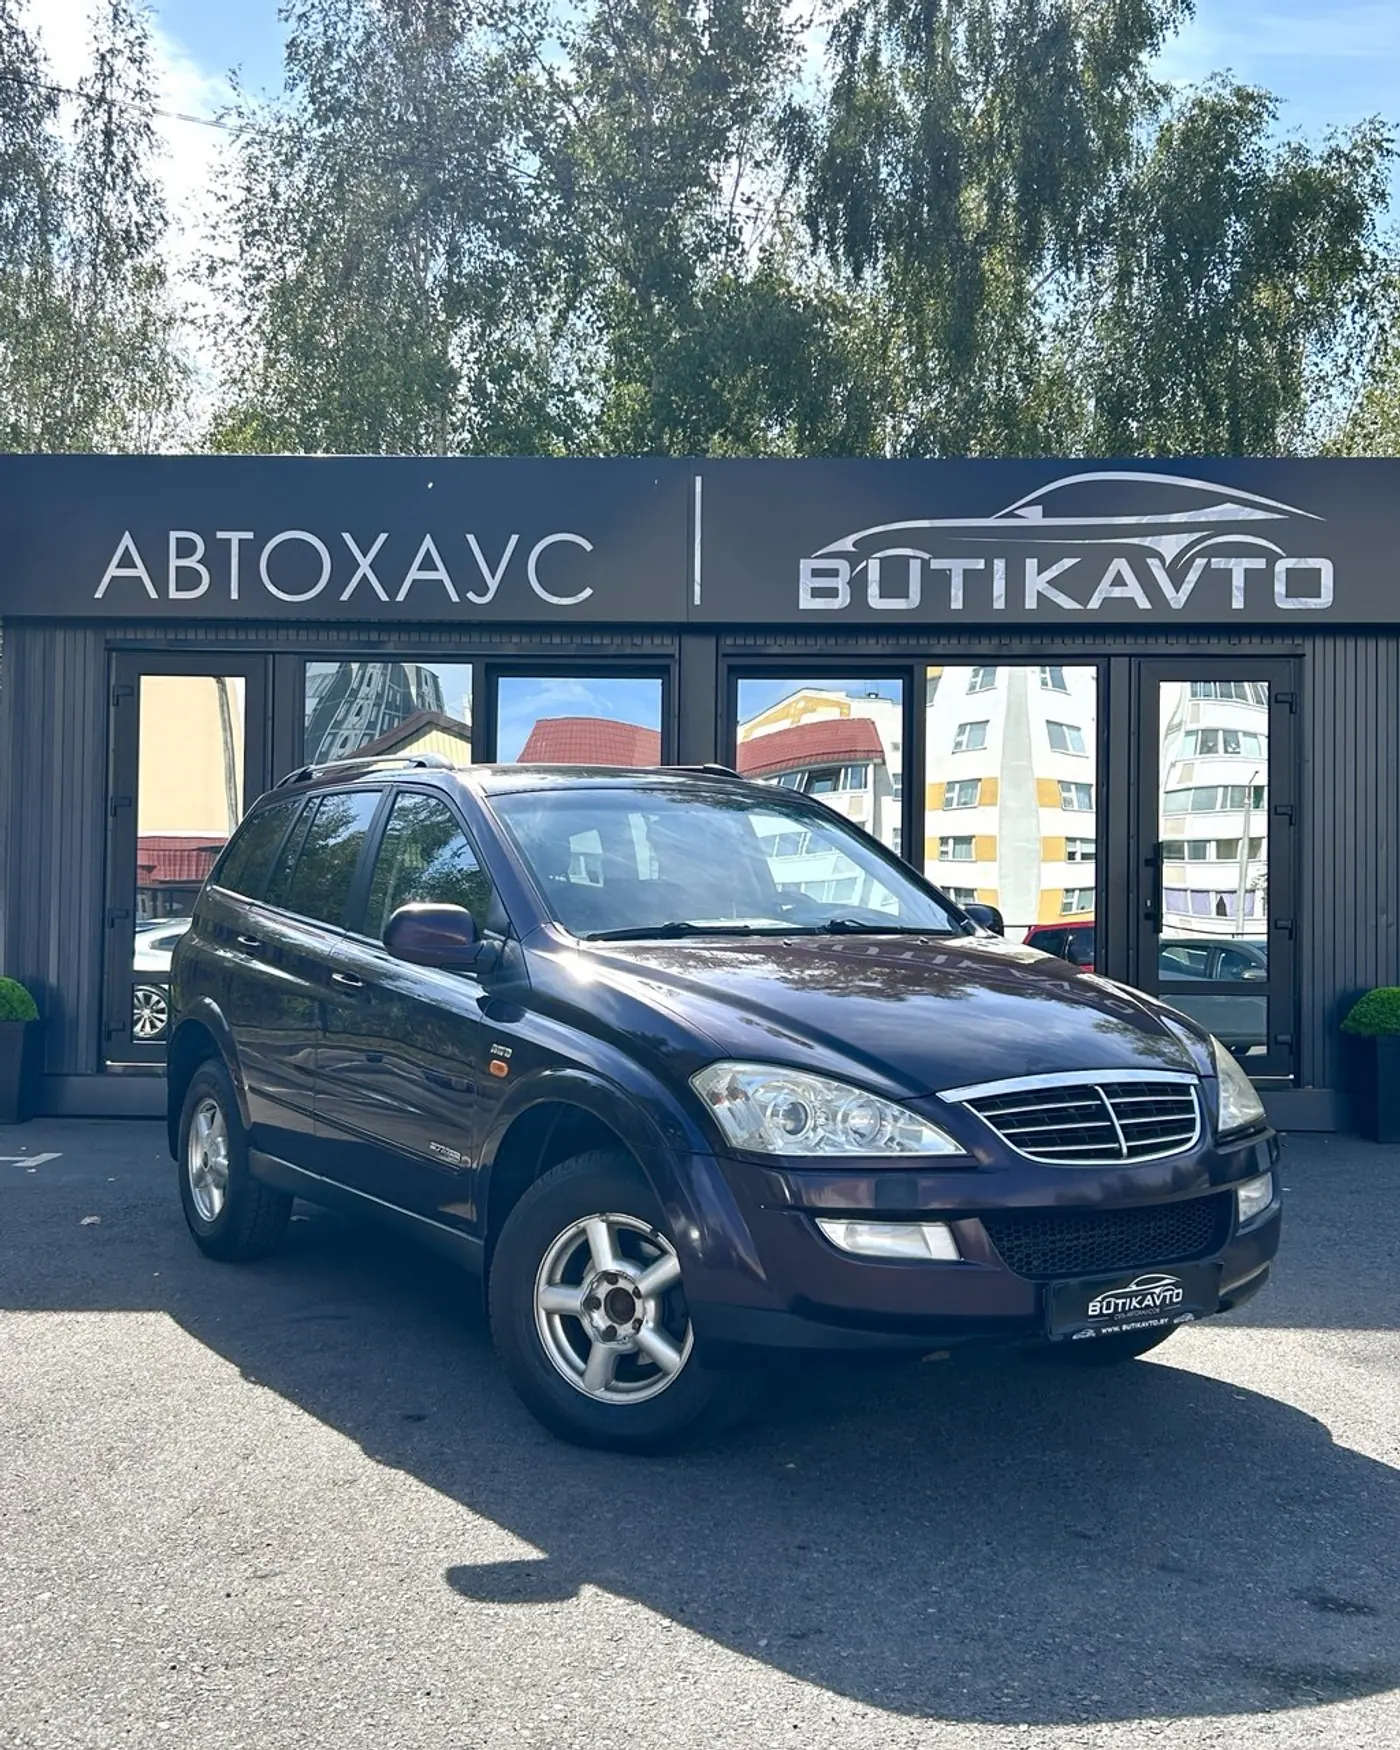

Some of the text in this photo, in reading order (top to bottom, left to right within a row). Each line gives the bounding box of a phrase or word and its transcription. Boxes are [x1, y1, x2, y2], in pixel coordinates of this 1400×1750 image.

[94, 530, 594, 606] АВТОХАУС
[799, 557, 1334, 610] BUTIKAVTO
[1088, 1288, 1182, 1315] BUTIKAVTO
